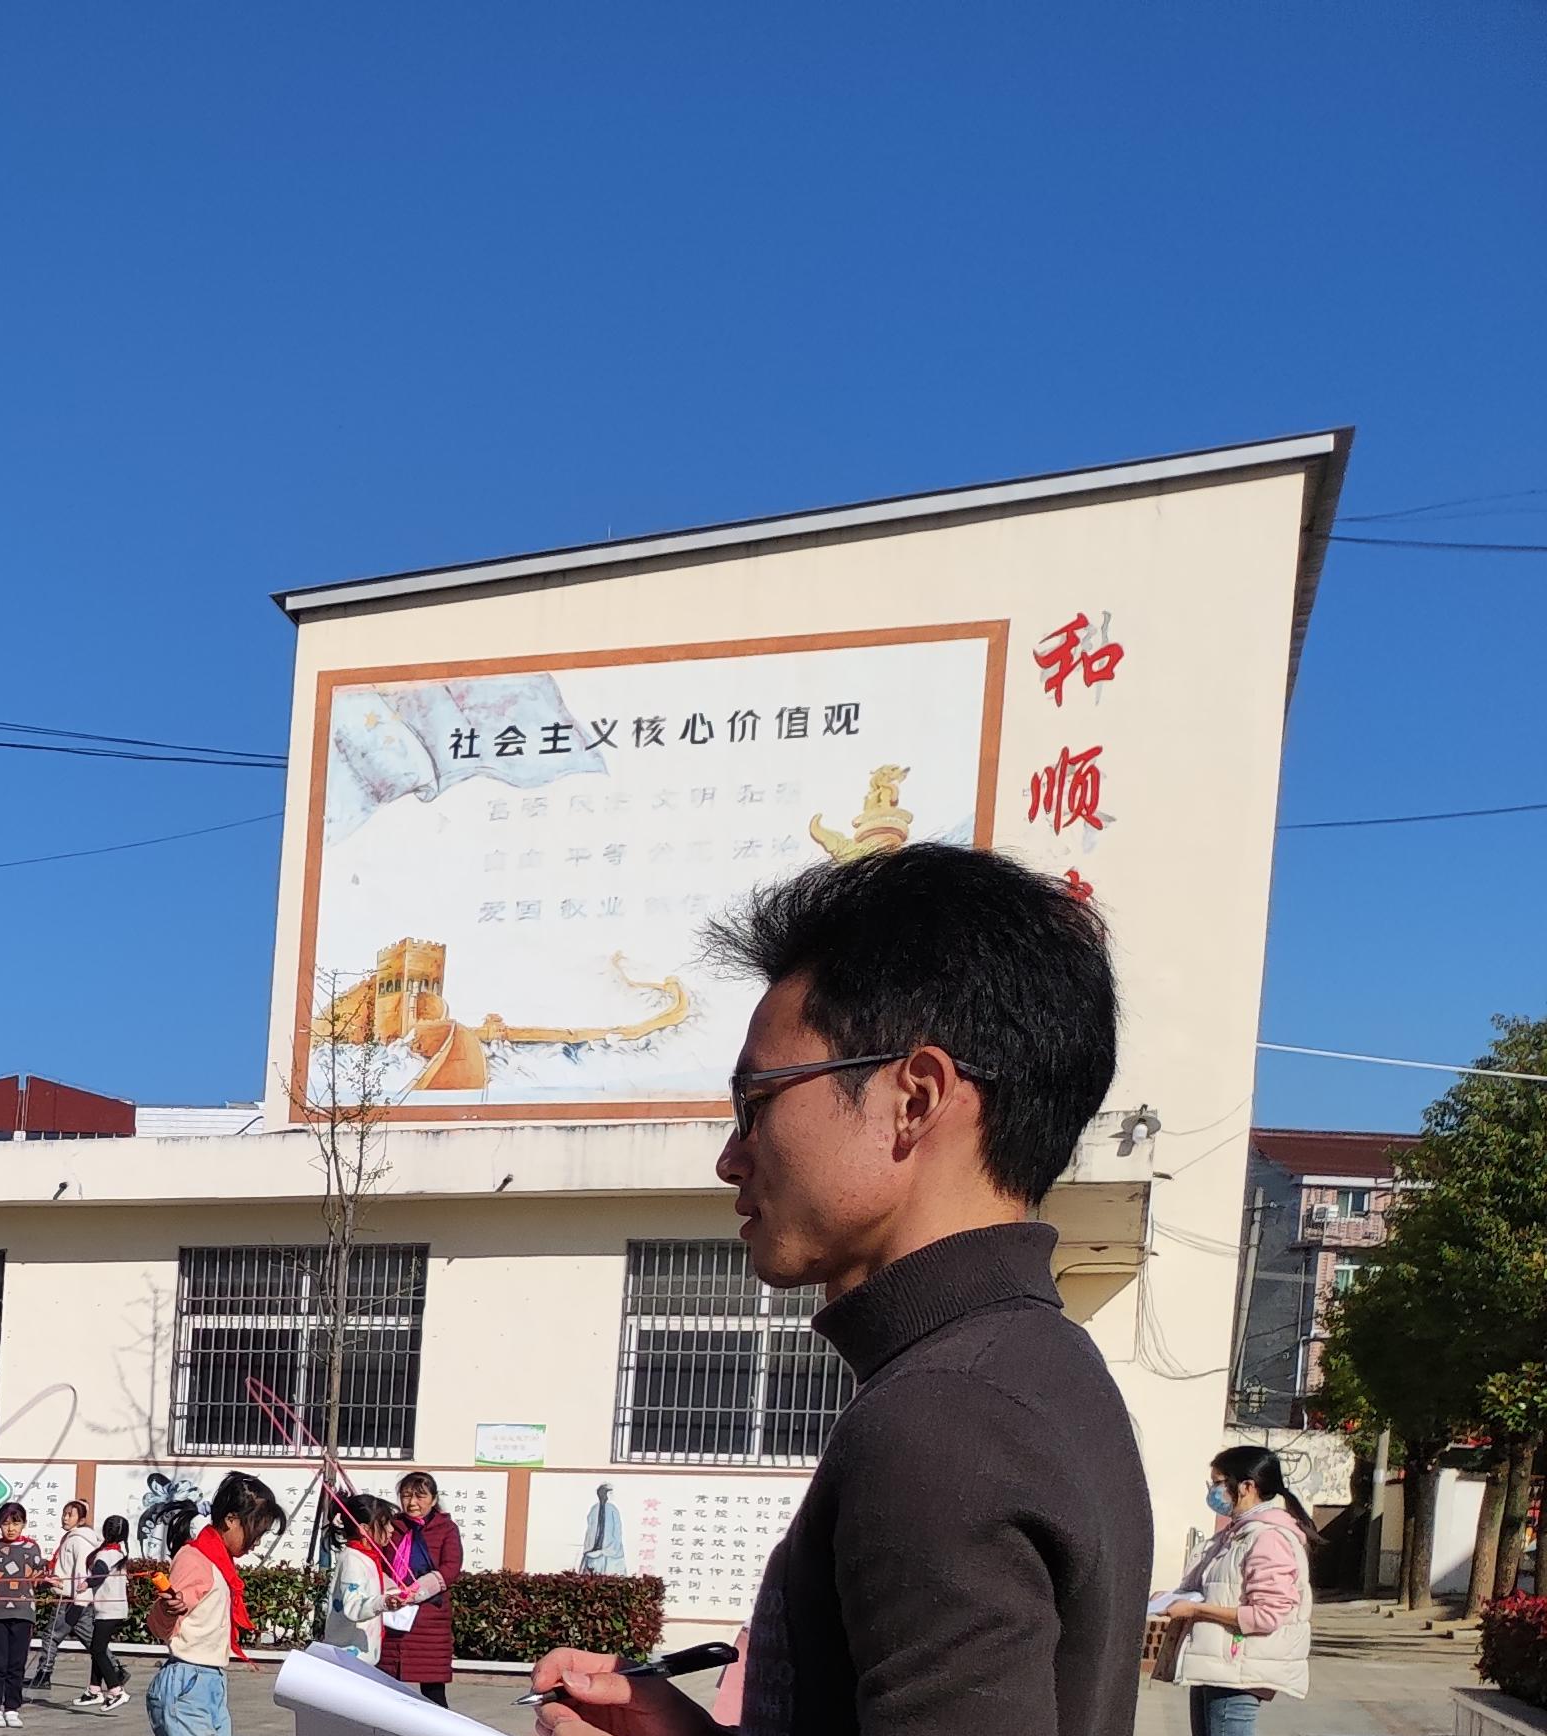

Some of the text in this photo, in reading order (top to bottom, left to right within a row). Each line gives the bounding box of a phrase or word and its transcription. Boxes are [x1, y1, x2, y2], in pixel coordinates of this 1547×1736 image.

[448, 702, 861, 760] 社会主义核心价值观
[1028, 612, 1121, 904] 和顺
[477, 898, 542, 923] 爱国
